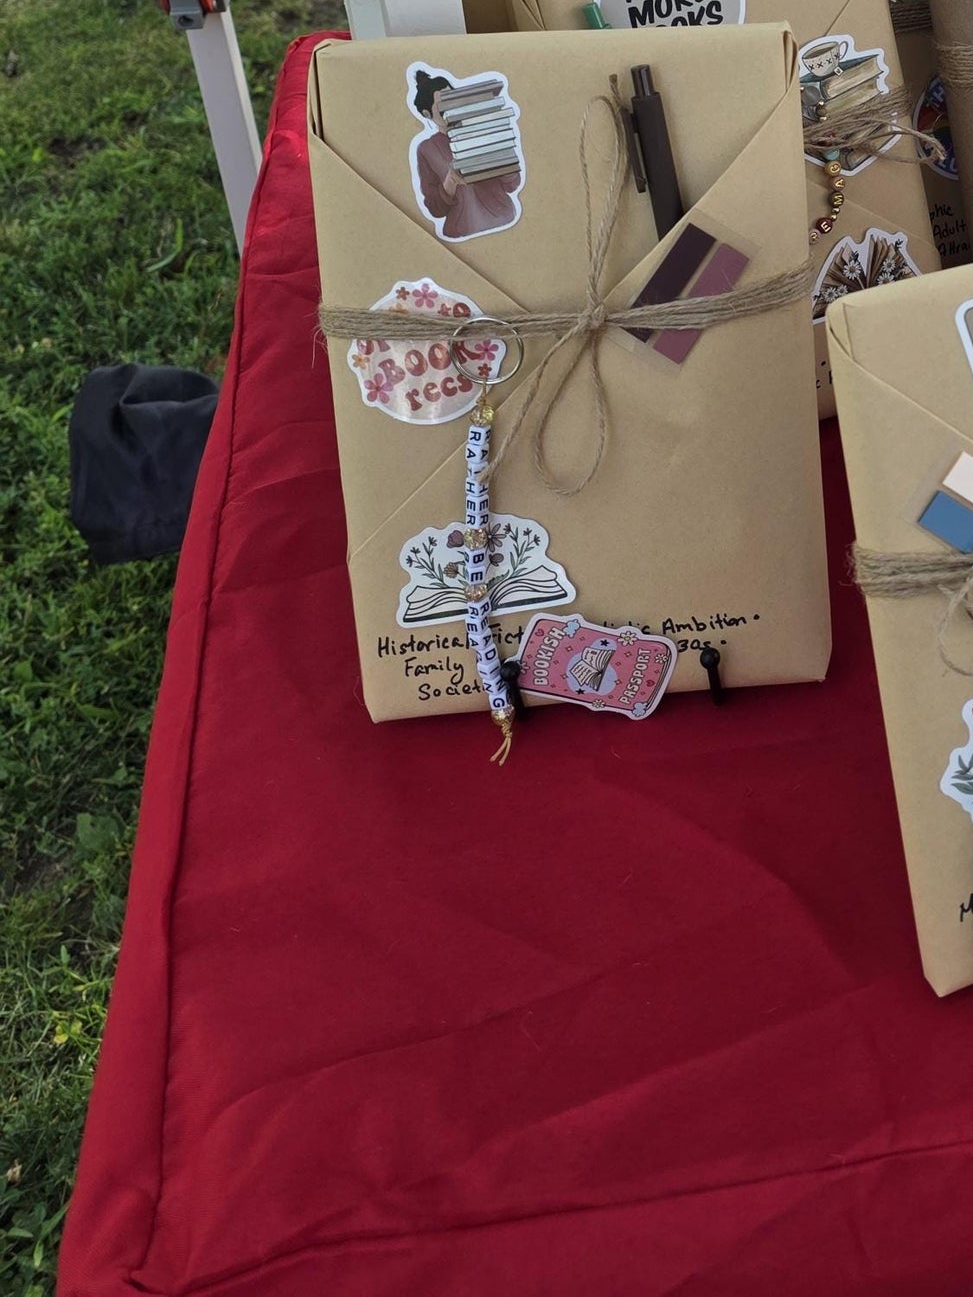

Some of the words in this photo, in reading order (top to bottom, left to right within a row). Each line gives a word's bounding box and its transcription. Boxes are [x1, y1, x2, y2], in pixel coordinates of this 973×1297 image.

[378, 341, 482, 386] BOOK
[405, 374, 474, 412] recs
[466, 428, 492, 527] RATHER
[466, 551, 487, 583] BE
[662, 613, 748, 636] Ambition
[404, 658, 465, 685] Family
[468, 600, 509, 710] READING
[533, 626, 566, 687] BOOKISH
[618, 646, 652, 705] PASSPORT
